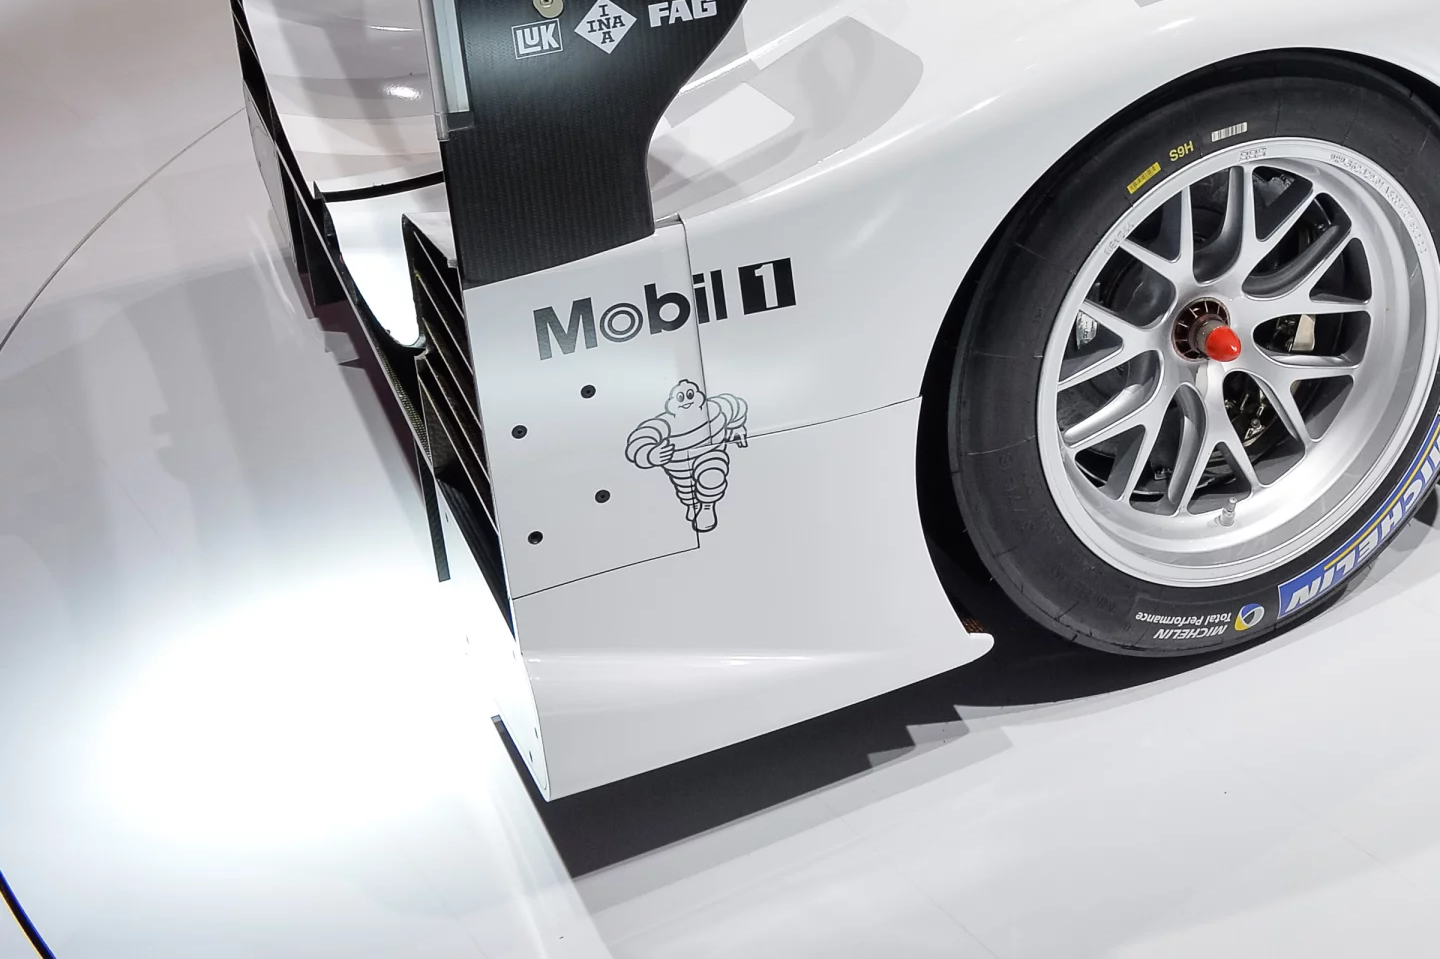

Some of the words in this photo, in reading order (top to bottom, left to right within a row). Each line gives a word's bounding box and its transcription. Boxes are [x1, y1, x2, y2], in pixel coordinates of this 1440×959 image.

[1168, 140, 1195, 162] S9H
[532, 268, 729, 361] Mobil
[1135, 611, 1205, 625] Performance
[1204, 612, 1232, 626] Total
[1152, 623, 1229, 640] MICHELIN
